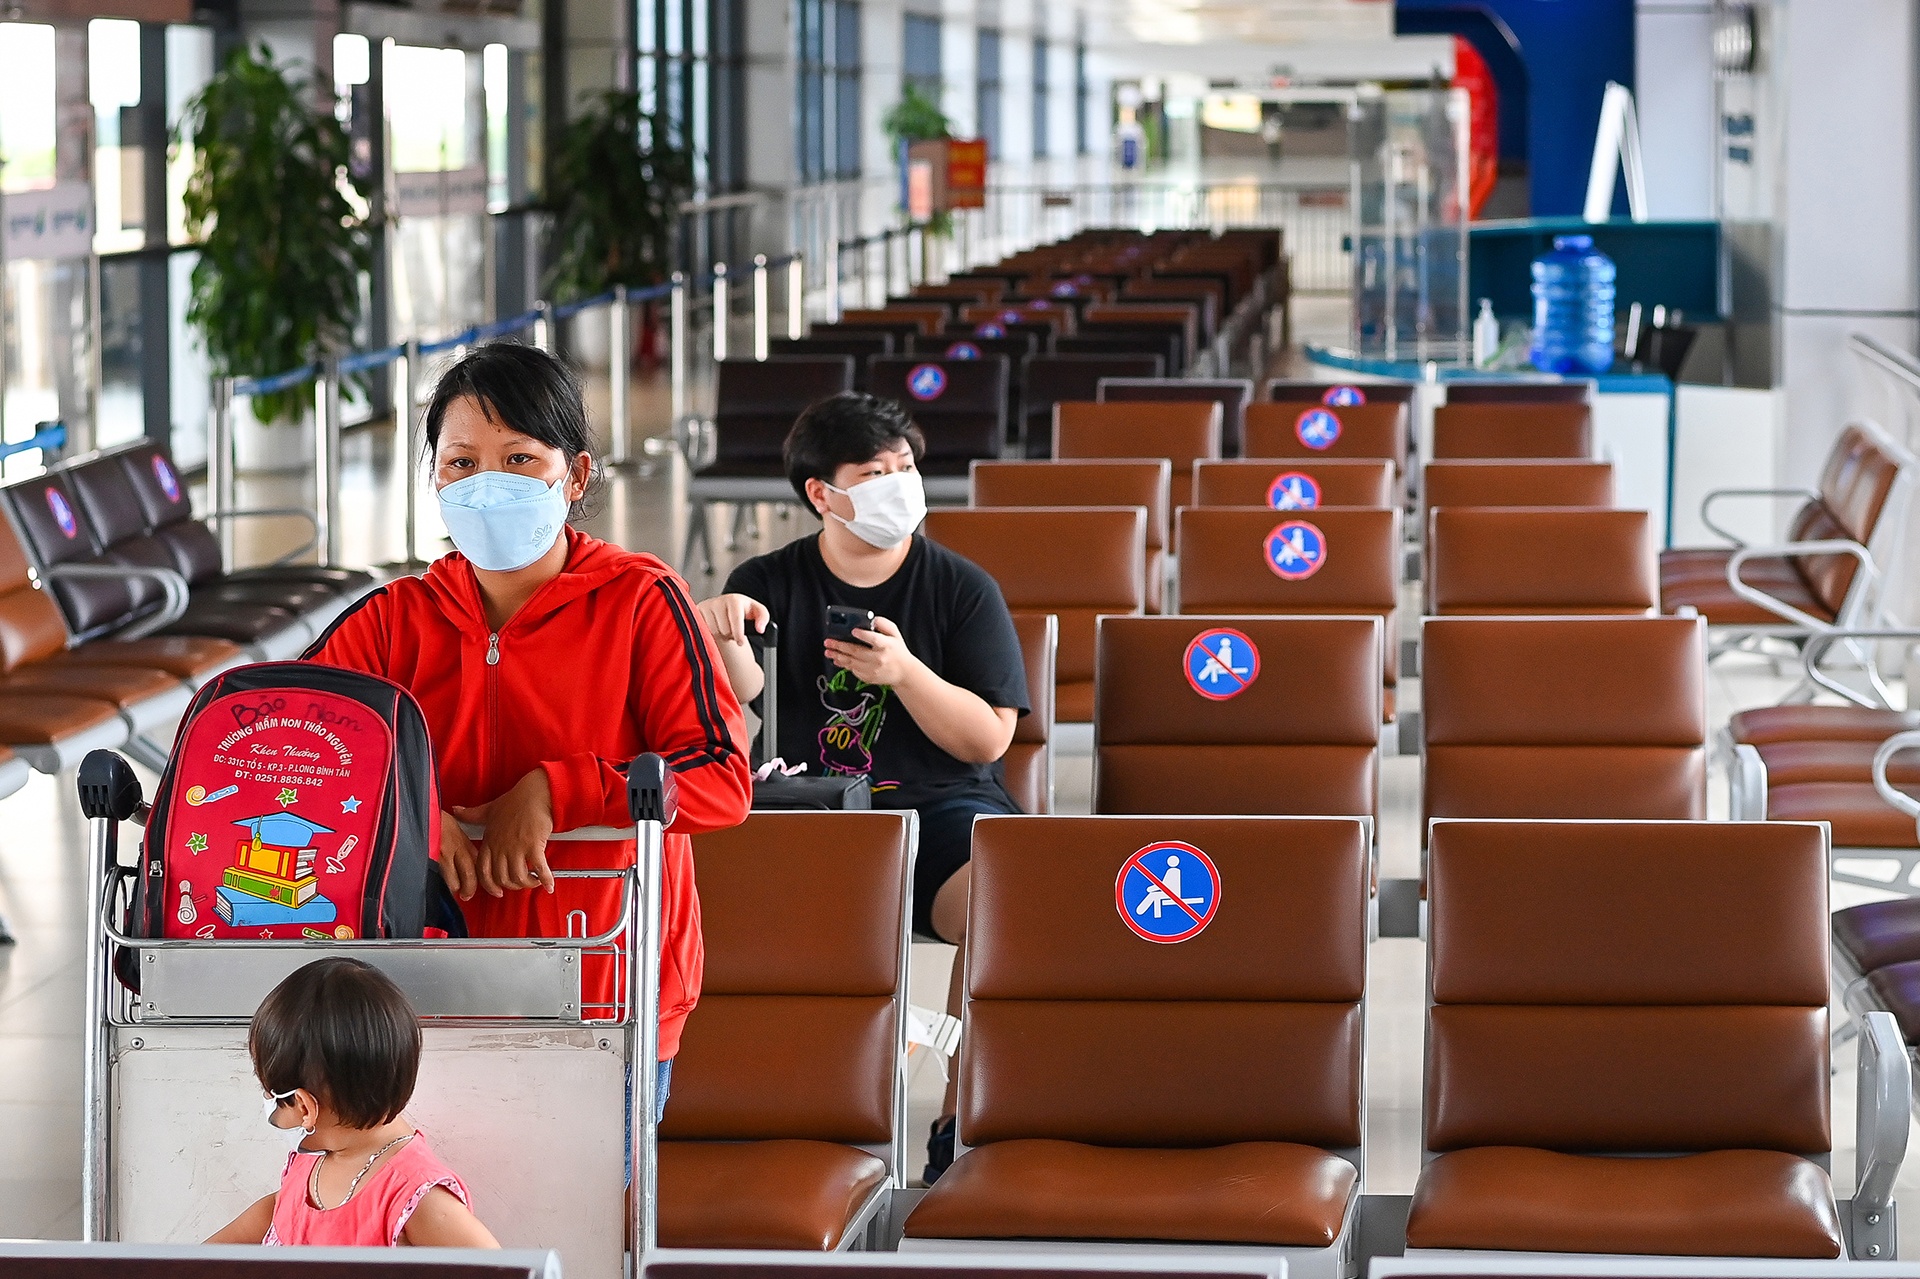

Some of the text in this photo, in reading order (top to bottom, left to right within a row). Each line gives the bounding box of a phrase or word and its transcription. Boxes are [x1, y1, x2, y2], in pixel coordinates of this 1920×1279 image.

[281, 718, 302, 729] NON
[250, 743, 278, 756] Khen
[213, 754, 227, 764] ĐC:
[227, 756, 245, 768] 331C
[257, 762, 263, 770] 5
[267, 762, 283, 772] KP.3
[288, 763, 315, 774] P.LONG
[316, 765, 335, 776] BÌNH
[235, 769, 323, 787] ĐT: 0251.8836.842
